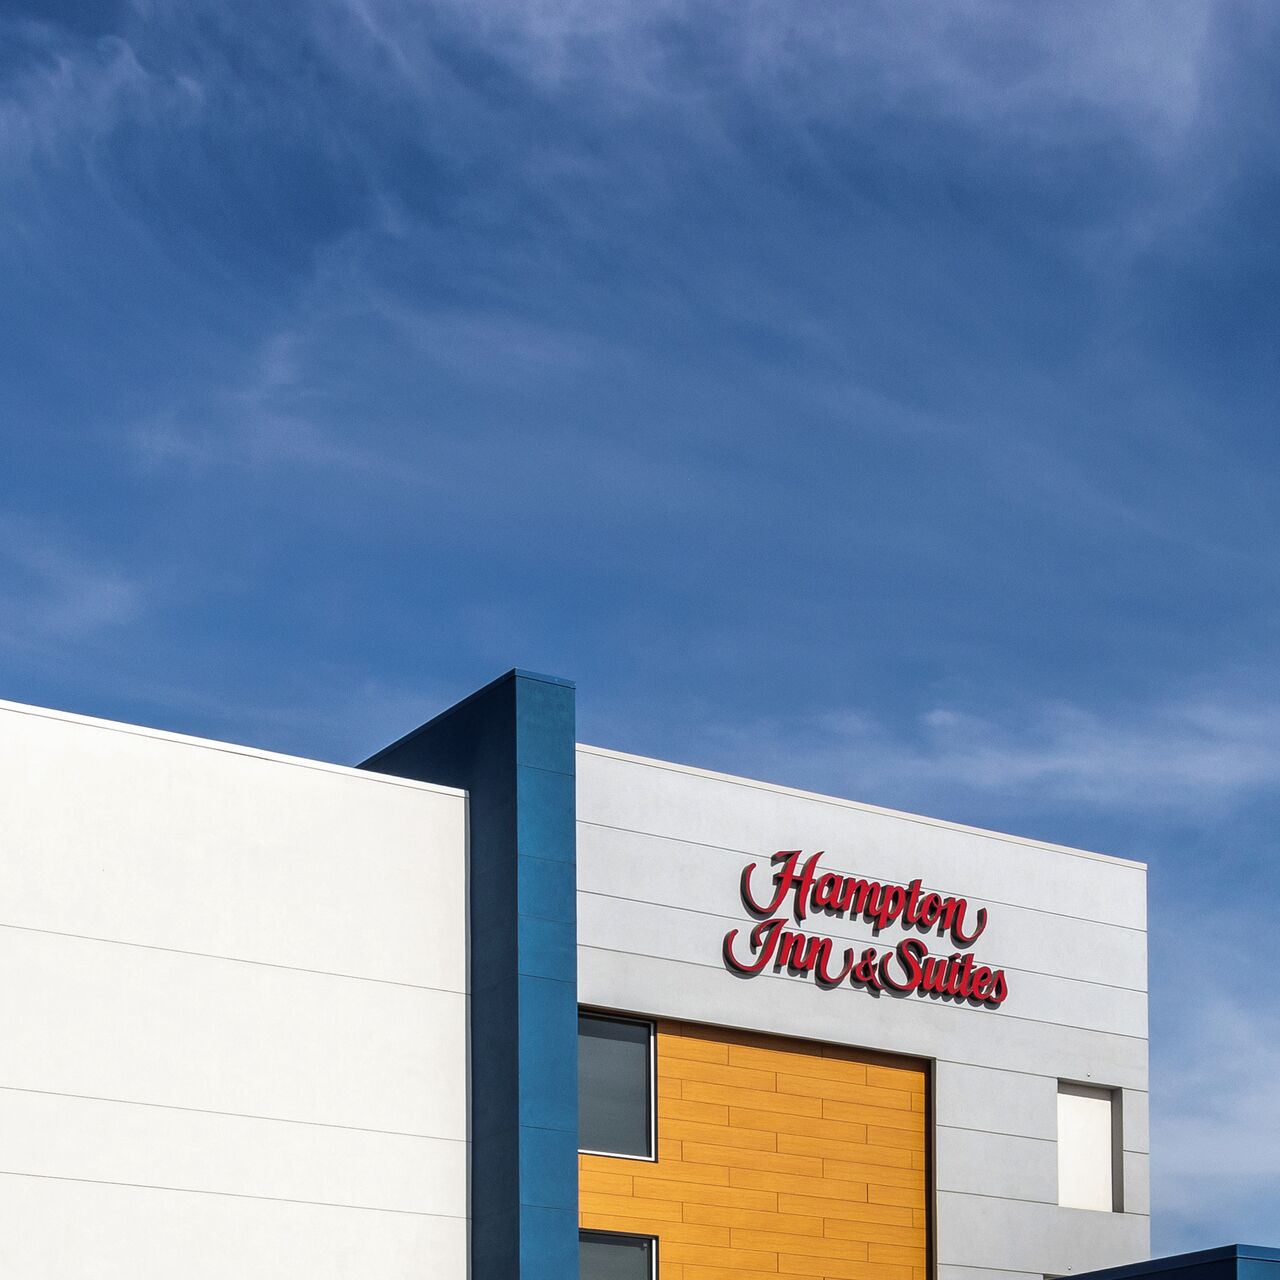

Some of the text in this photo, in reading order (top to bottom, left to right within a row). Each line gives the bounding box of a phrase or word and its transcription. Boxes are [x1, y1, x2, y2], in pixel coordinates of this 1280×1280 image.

[740, 850, 987, 949] Hampton
[723, 919, 1009, 1009] Inn & Suites
